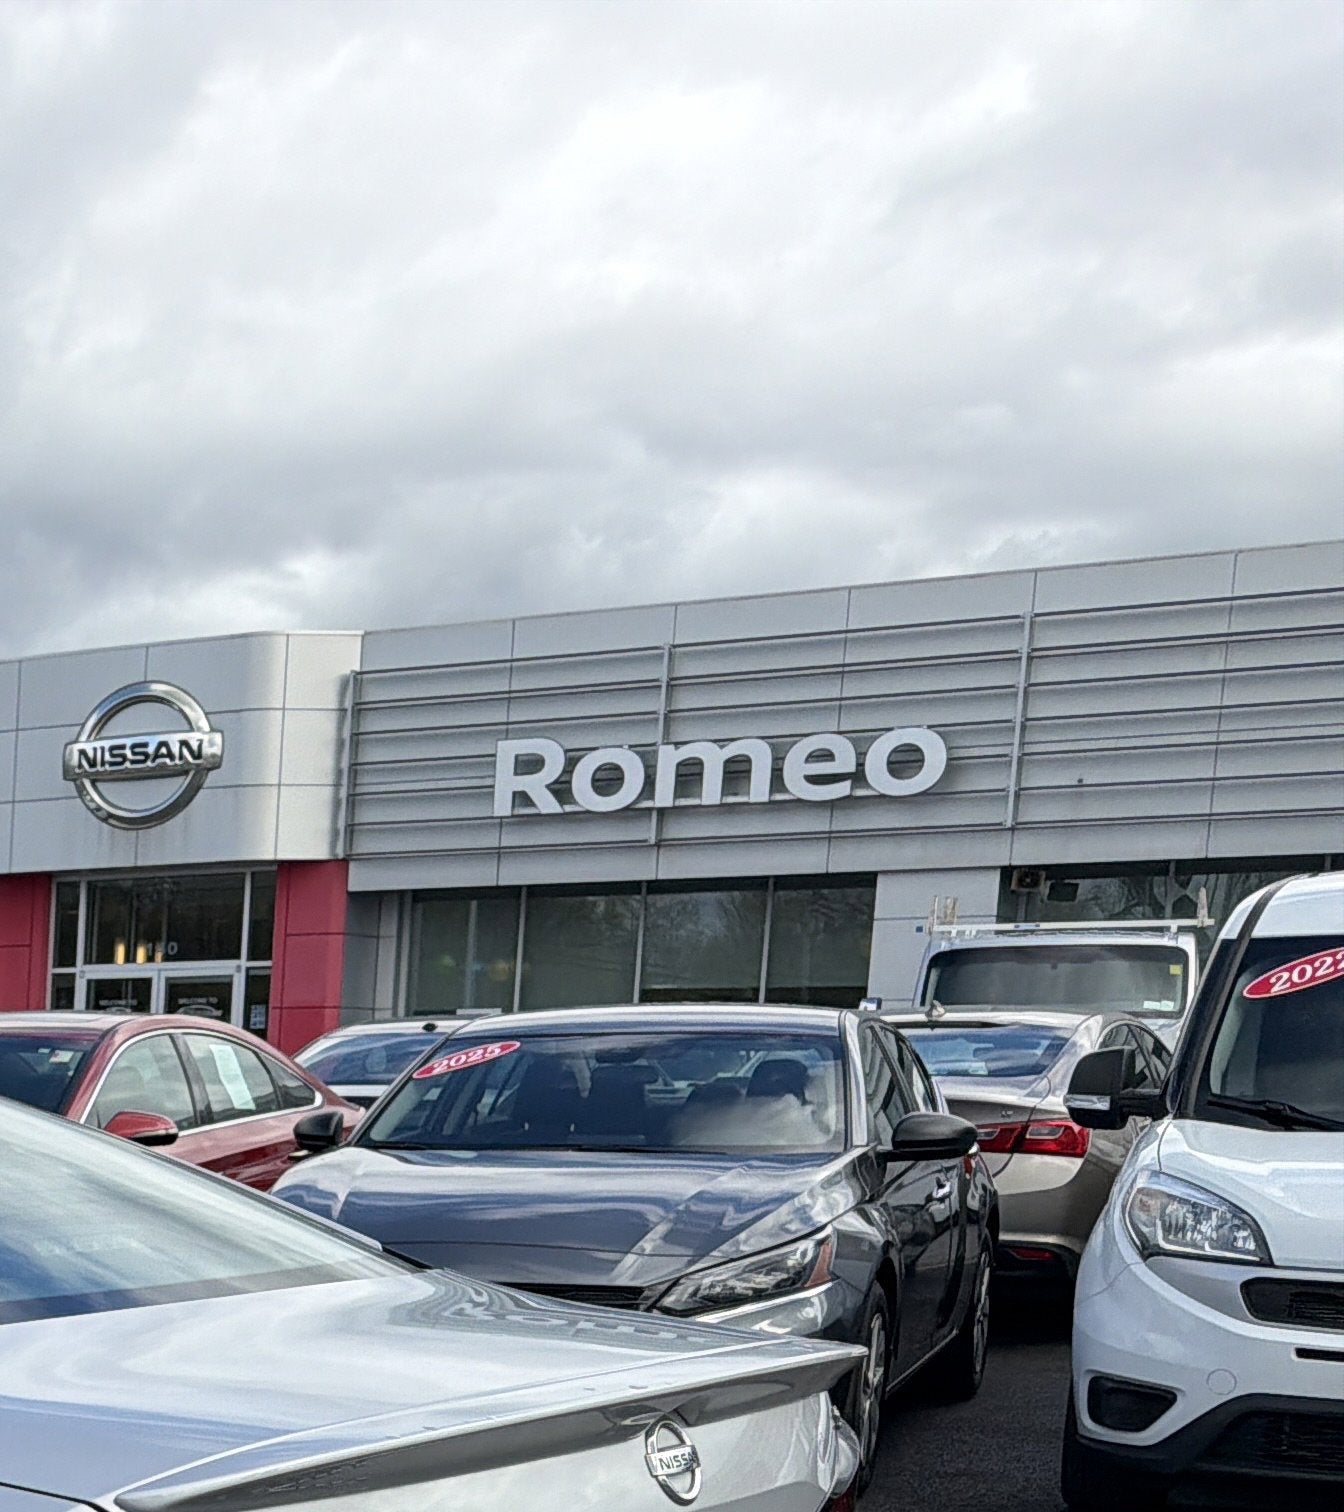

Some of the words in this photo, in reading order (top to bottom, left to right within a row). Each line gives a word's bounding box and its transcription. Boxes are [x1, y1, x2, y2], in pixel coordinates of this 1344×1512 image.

[76, 738, 204, 770] NISSAN
[493, 725, 948, 817] Romeo
[432, 1046, 502, 1074] 2025
